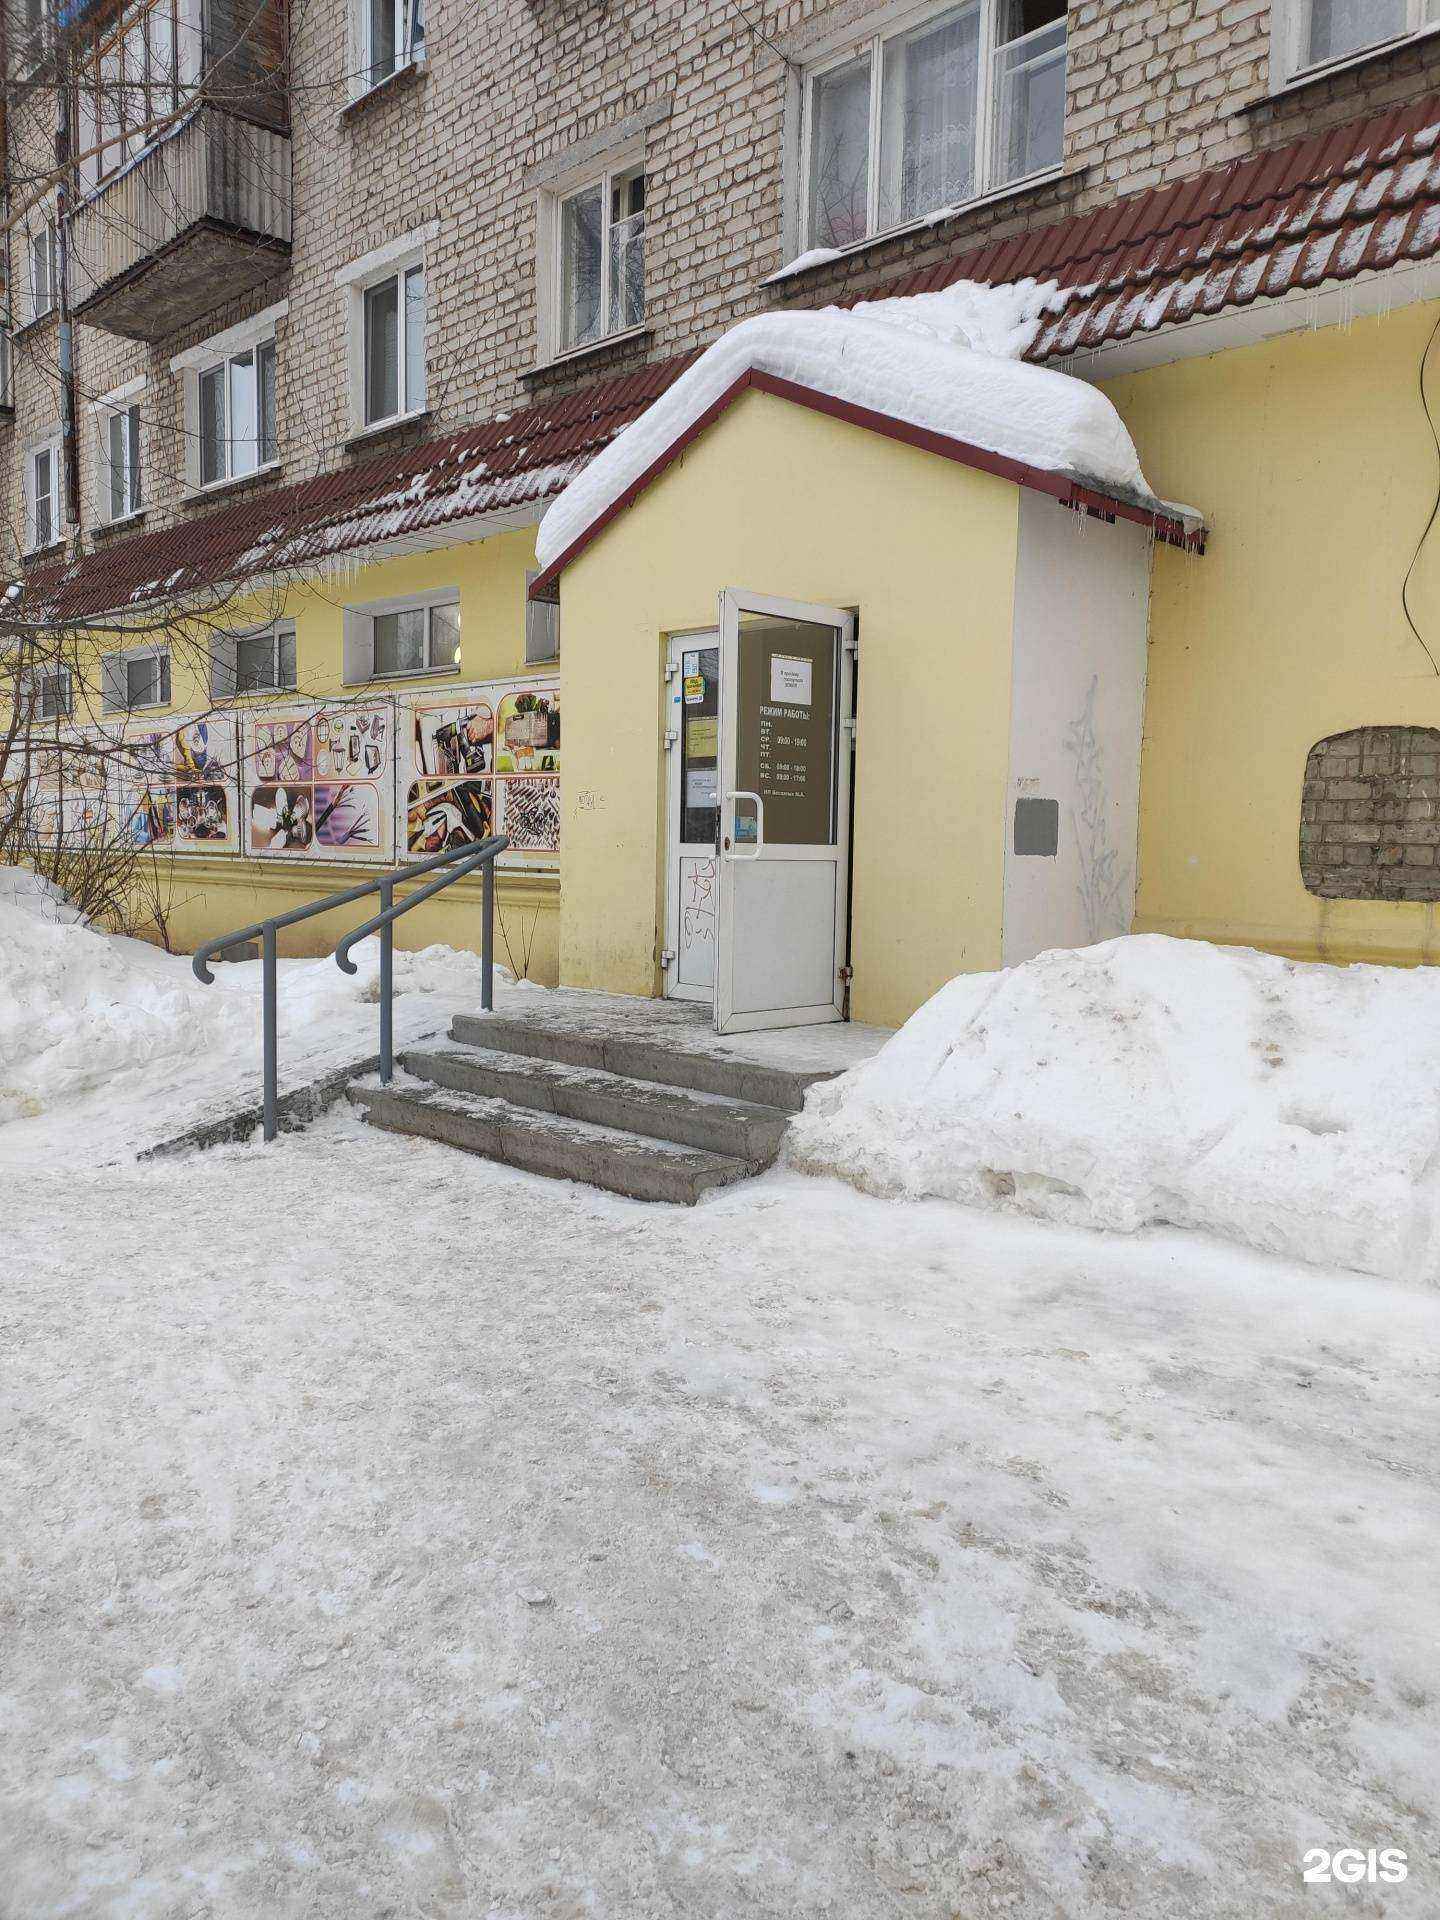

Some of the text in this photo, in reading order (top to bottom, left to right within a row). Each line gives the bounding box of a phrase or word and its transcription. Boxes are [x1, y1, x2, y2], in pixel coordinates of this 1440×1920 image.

[759, 705, 810, 720] РЕЖИМ РАБОТЫ:
[760, 720, 773, 728] ПН.
